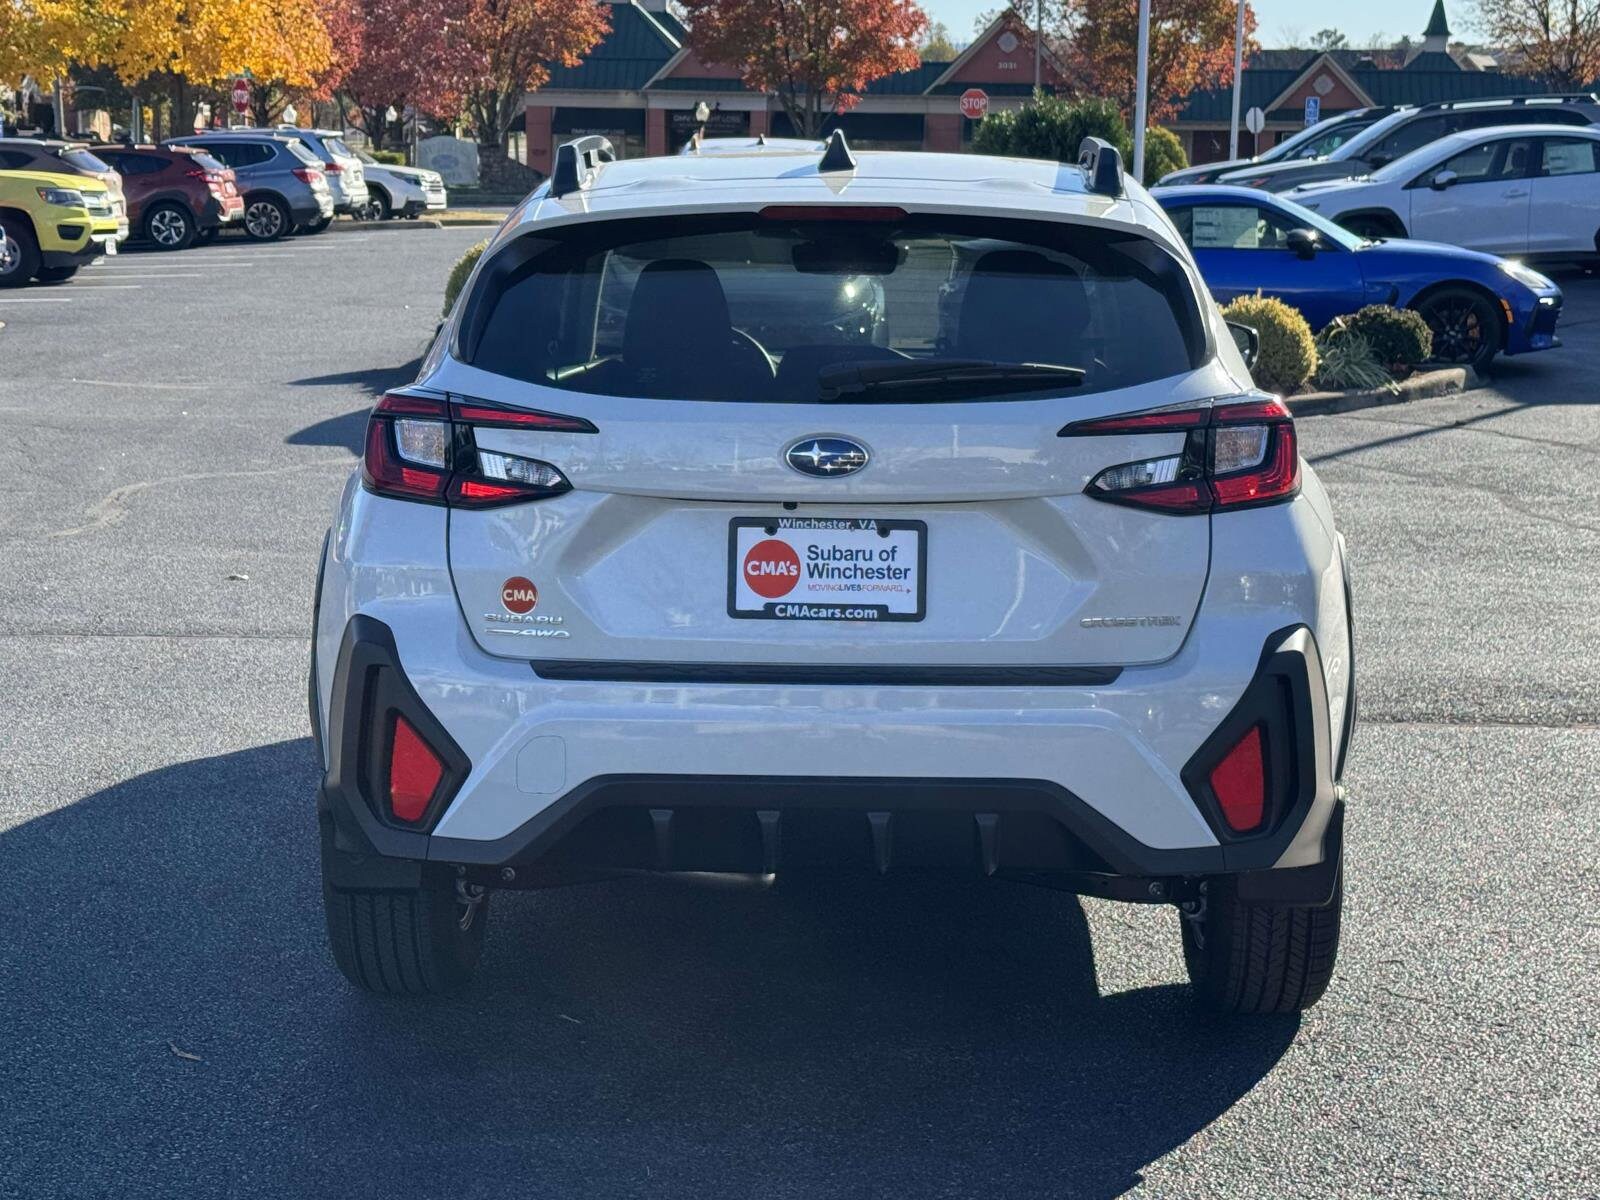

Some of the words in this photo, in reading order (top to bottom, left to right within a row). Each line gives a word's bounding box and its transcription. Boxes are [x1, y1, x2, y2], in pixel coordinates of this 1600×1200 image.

[961, 98, 986, 110] STOP
[778, 518, 855, 532] Winchester,
[859, 519, 878, 530] VA
[806, 545, 873, 562] Subaru
[879, 545, 898, 562] of
[746, 560, 798, 576] CMA's
[806, 563, 911, 580] Winchester
[503, 589, 536, 602] CMA
[774, 604, 878, 619] CMAcars.com
[483, 613, 564, 625] SUBARU
[1080, 616, 1181, 628] CROSSTREK
[517, 628, 571, 639] AWD
